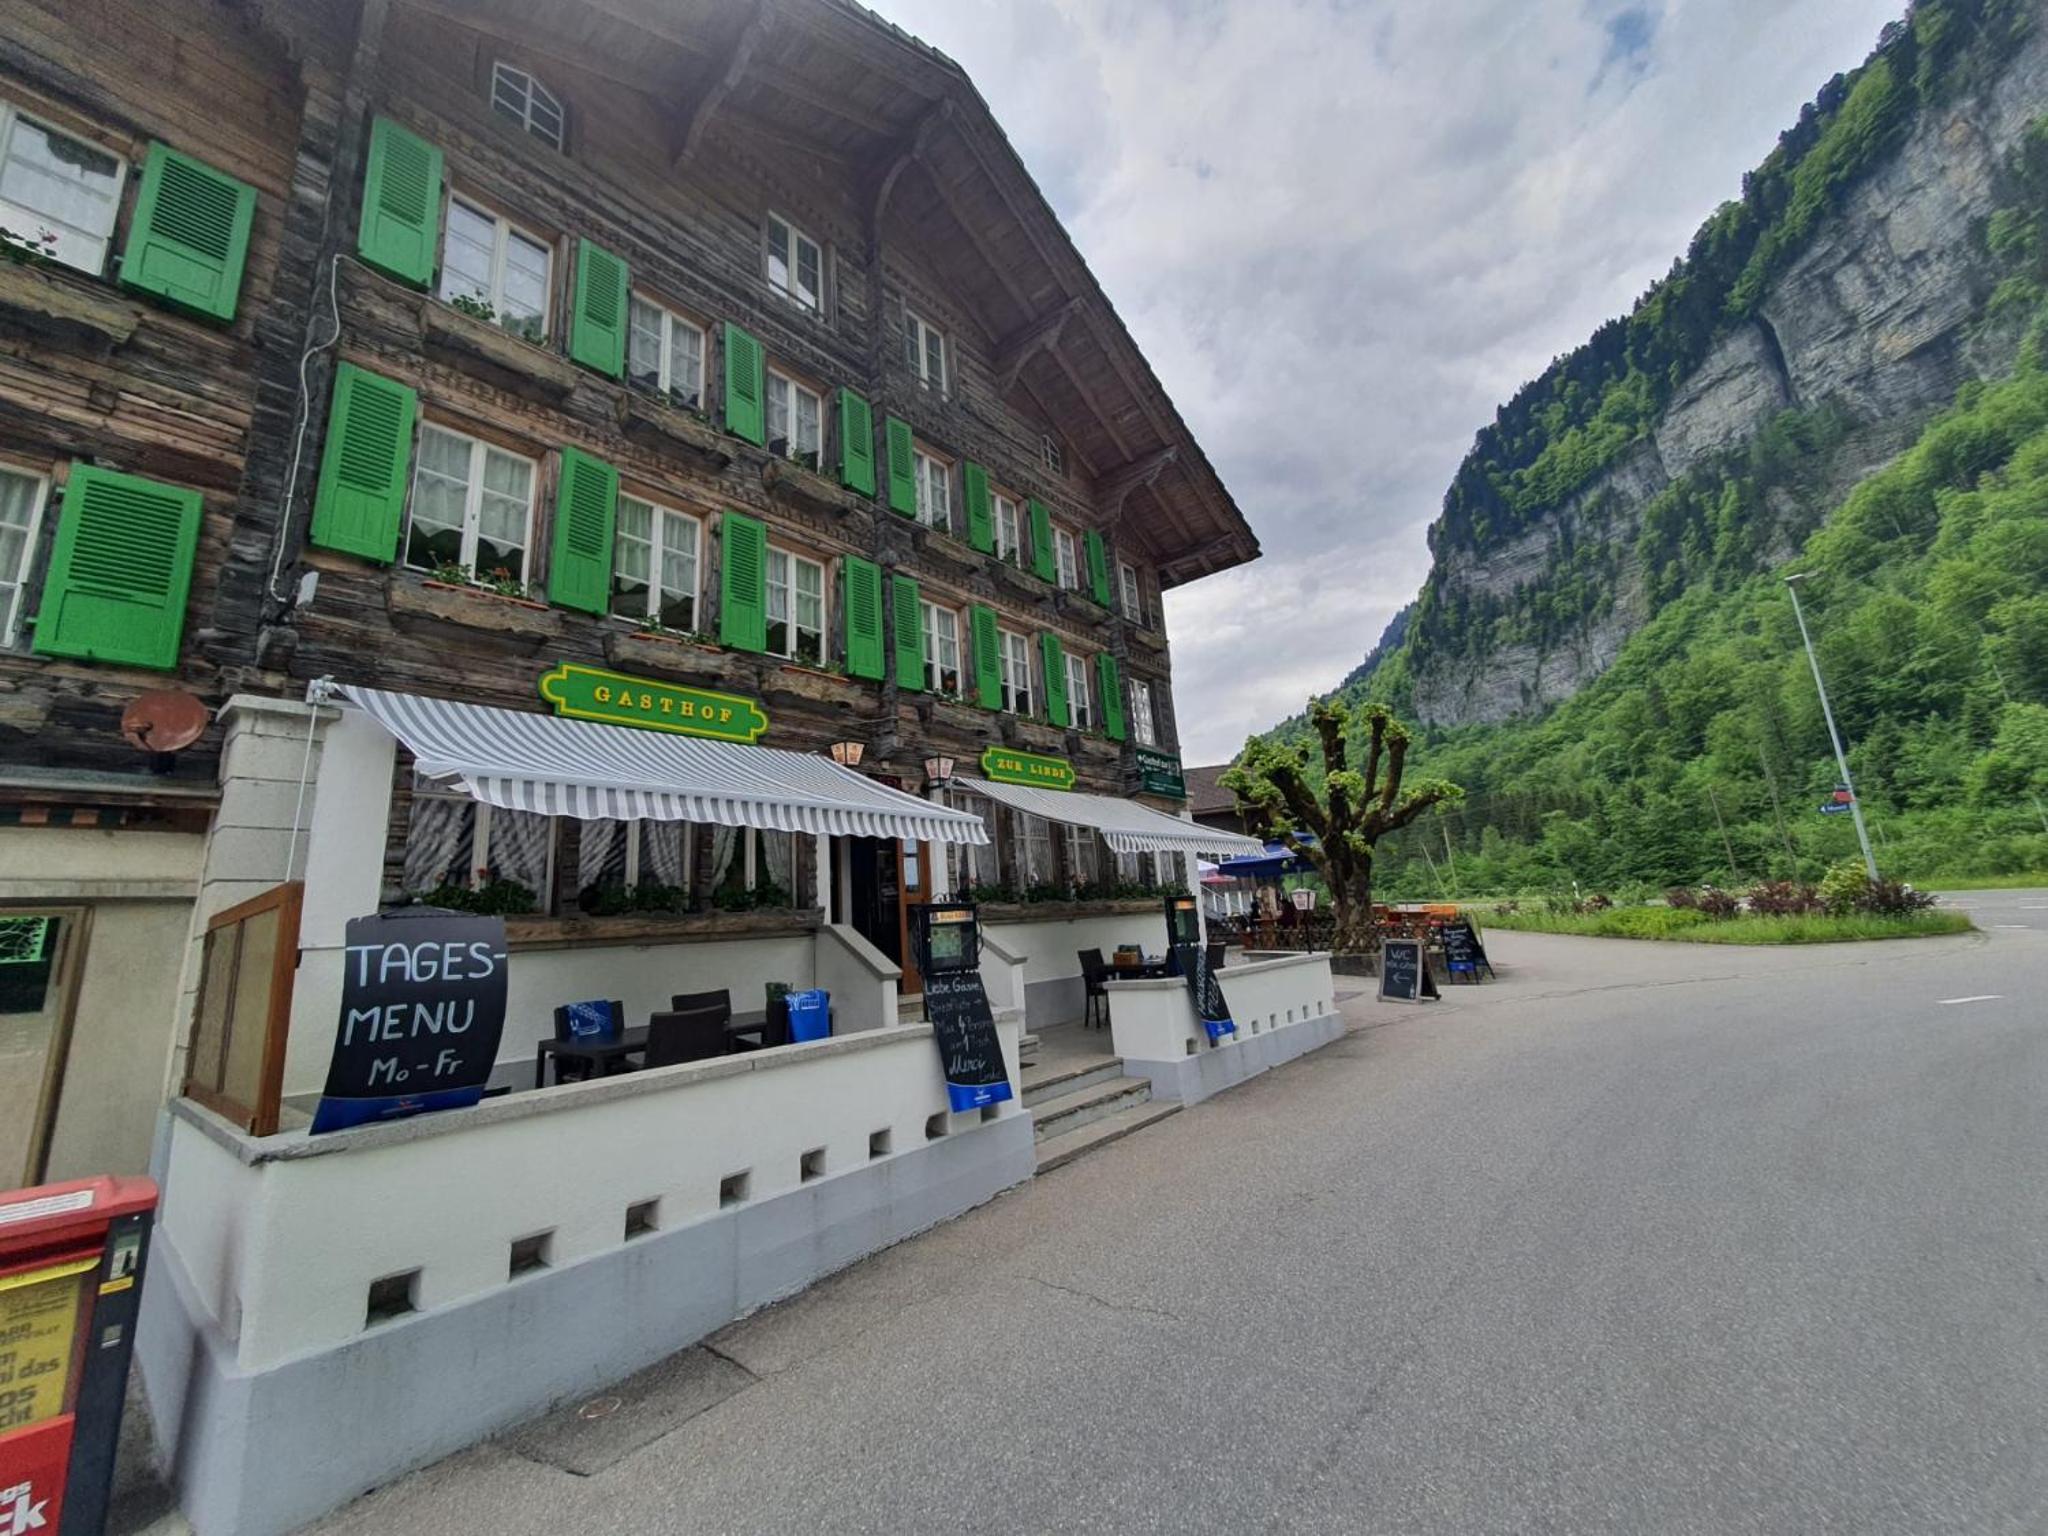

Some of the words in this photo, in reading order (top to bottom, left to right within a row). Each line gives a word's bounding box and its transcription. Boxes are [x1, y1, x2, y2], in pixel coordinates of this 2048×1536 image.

[594, 686, 733, 723] GASTHOF
[996, 758, 1023, 772] ZUR
[1029, 763, 1066, 779] LINDE
[346, 942, 506, 987] TAGES-
[1390, 948, 1410, 960] WC
[343, 999, 474, 1046] MENU
[19, 1358, 60, 1379] das
